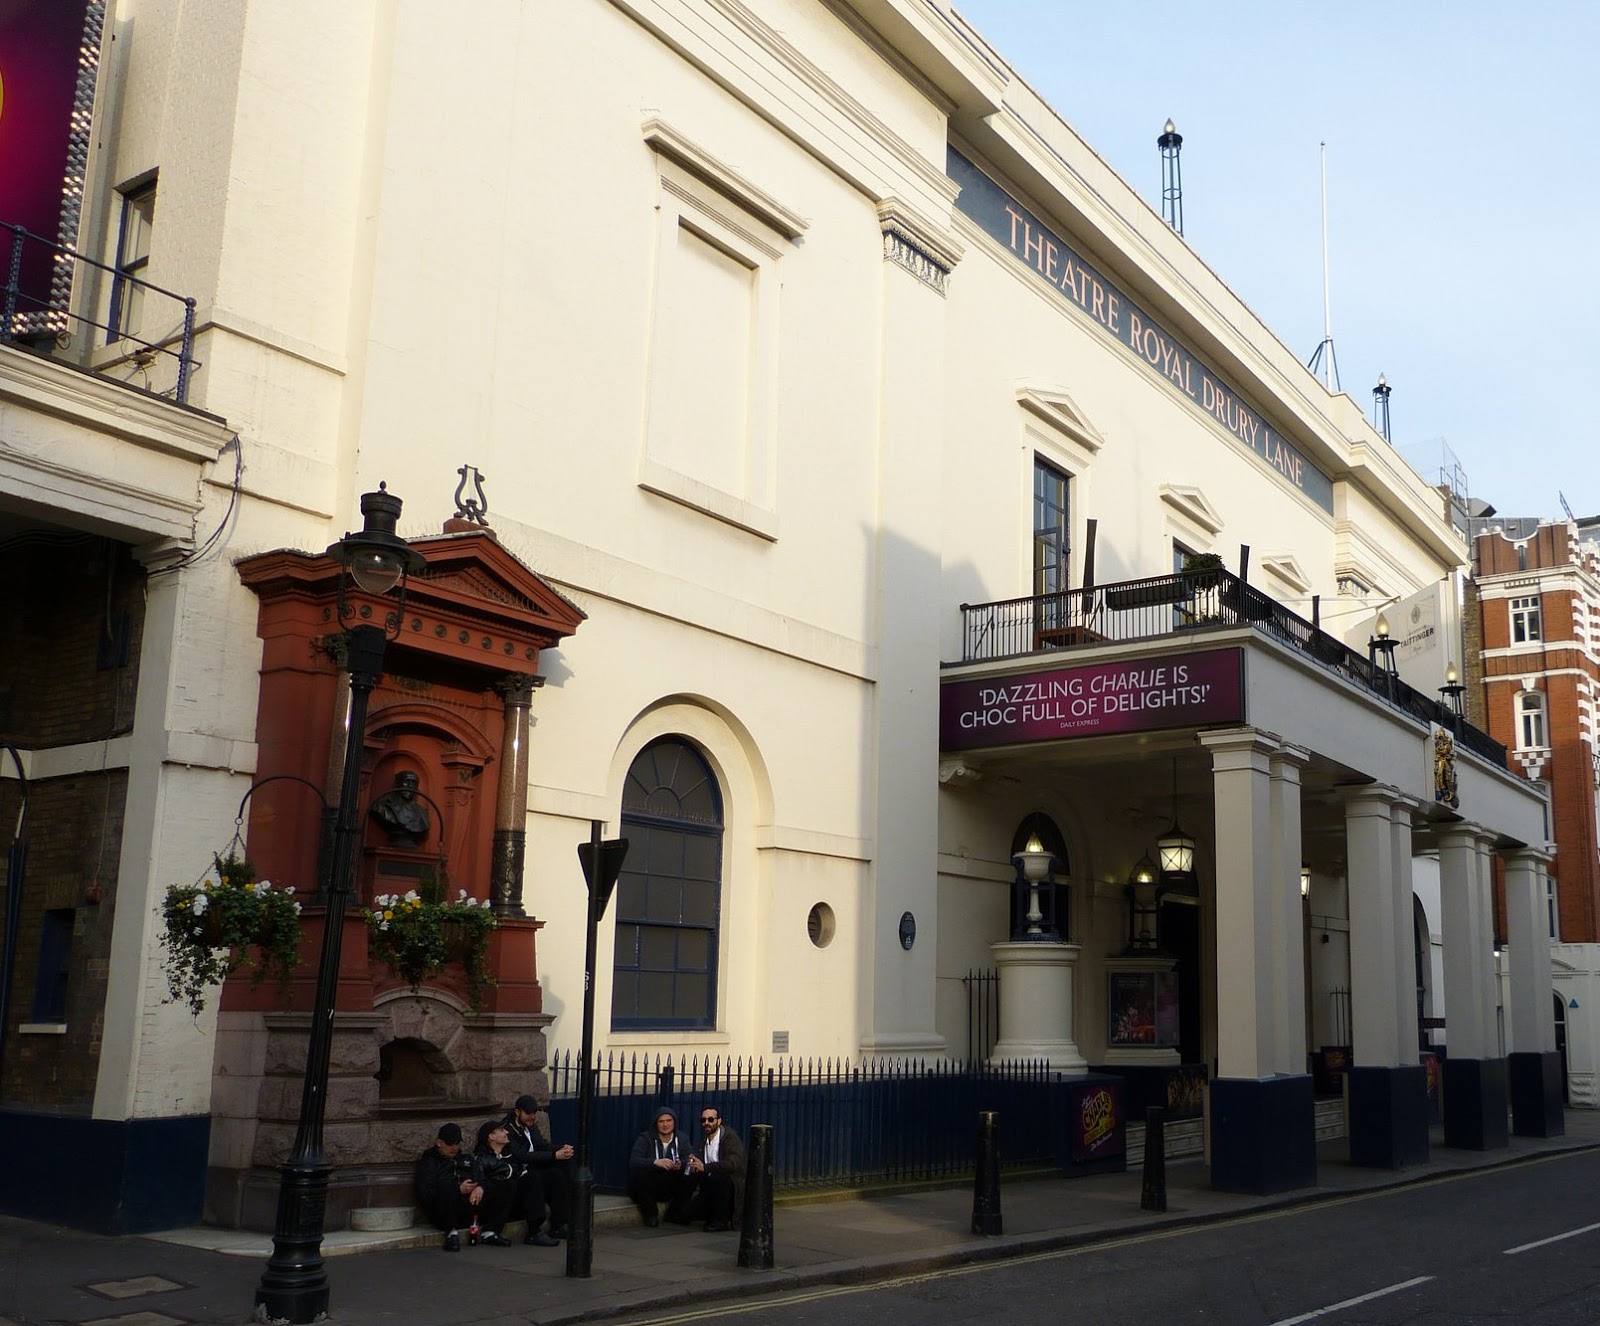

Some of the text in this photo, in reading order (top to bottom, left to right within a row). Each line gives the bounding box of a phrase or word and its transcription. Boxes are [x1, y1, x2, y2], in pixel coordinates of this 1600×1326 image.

[1005, 205, 1303, 488] THEATRE ROYAL DRURY LANE
[1400, 627, 1434, 648] TAITTINGER
[1090, 668, 1167, 693] CHARLIE
[1173, 665, 1189, 685] IS
[959, 707, 1016, 729] CHOC
[1022, 701, 1065, 723] FULL
[1071, 696, 1098, 717] OF
[1059, 718, 1100, 729] DAILY EXPRESS
